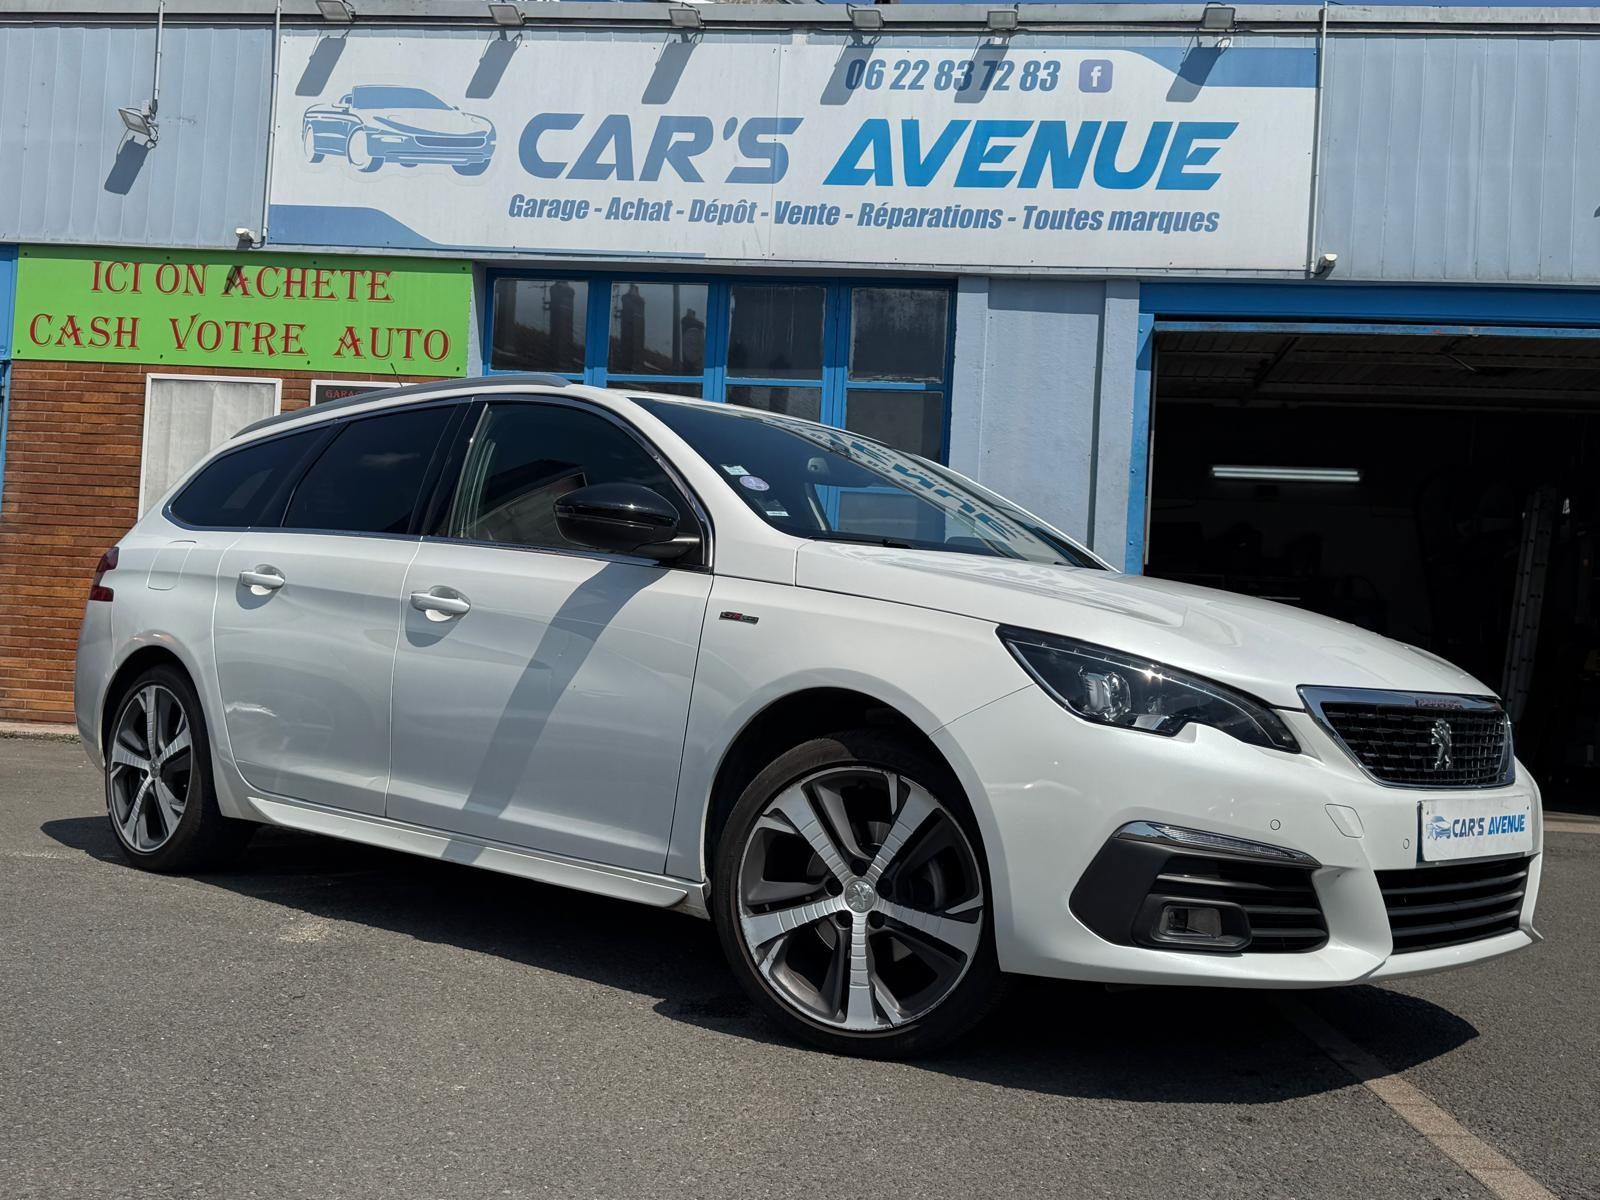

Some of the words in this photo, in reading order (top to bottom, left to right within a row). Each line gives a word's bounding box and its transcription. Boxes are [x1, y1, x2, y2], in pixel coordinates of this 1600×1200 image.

[846, 59, 886, 90] 06
[889, 59, 930, 90] 22
[933, 59, 975, 91] 83
[979, 60, 1015, 91] 72
[1019, 60, 1061, 91] 83
[518, 112, 804, 184] CAR'S
[822, 118, 1240, 190] AVENUE
[508, 194, 590, 221] Garage
[605, 197, 673, 221] Achat
[688, 199, 757, 225] Dépôt
[774, 200, 841, 226] Vente
[857, 202, 1004, 230] Réparations
[1022, 206, 1104, 231] Toutes
[1108, 211, 1220, 234] marques
[91, 261, 142, 294] ICI
[155, 263, 208, 297] ON
[222, 265, 394, 302] ACHETE
[29, 313, 140, 350] CASH
[169, 313, 308, 357] VOTRE
[333, 325, 451, 362] AUTO
[1452, 818, 1485, 838] CAR'S
[1488, 814, 1526, 835] AVENUE
